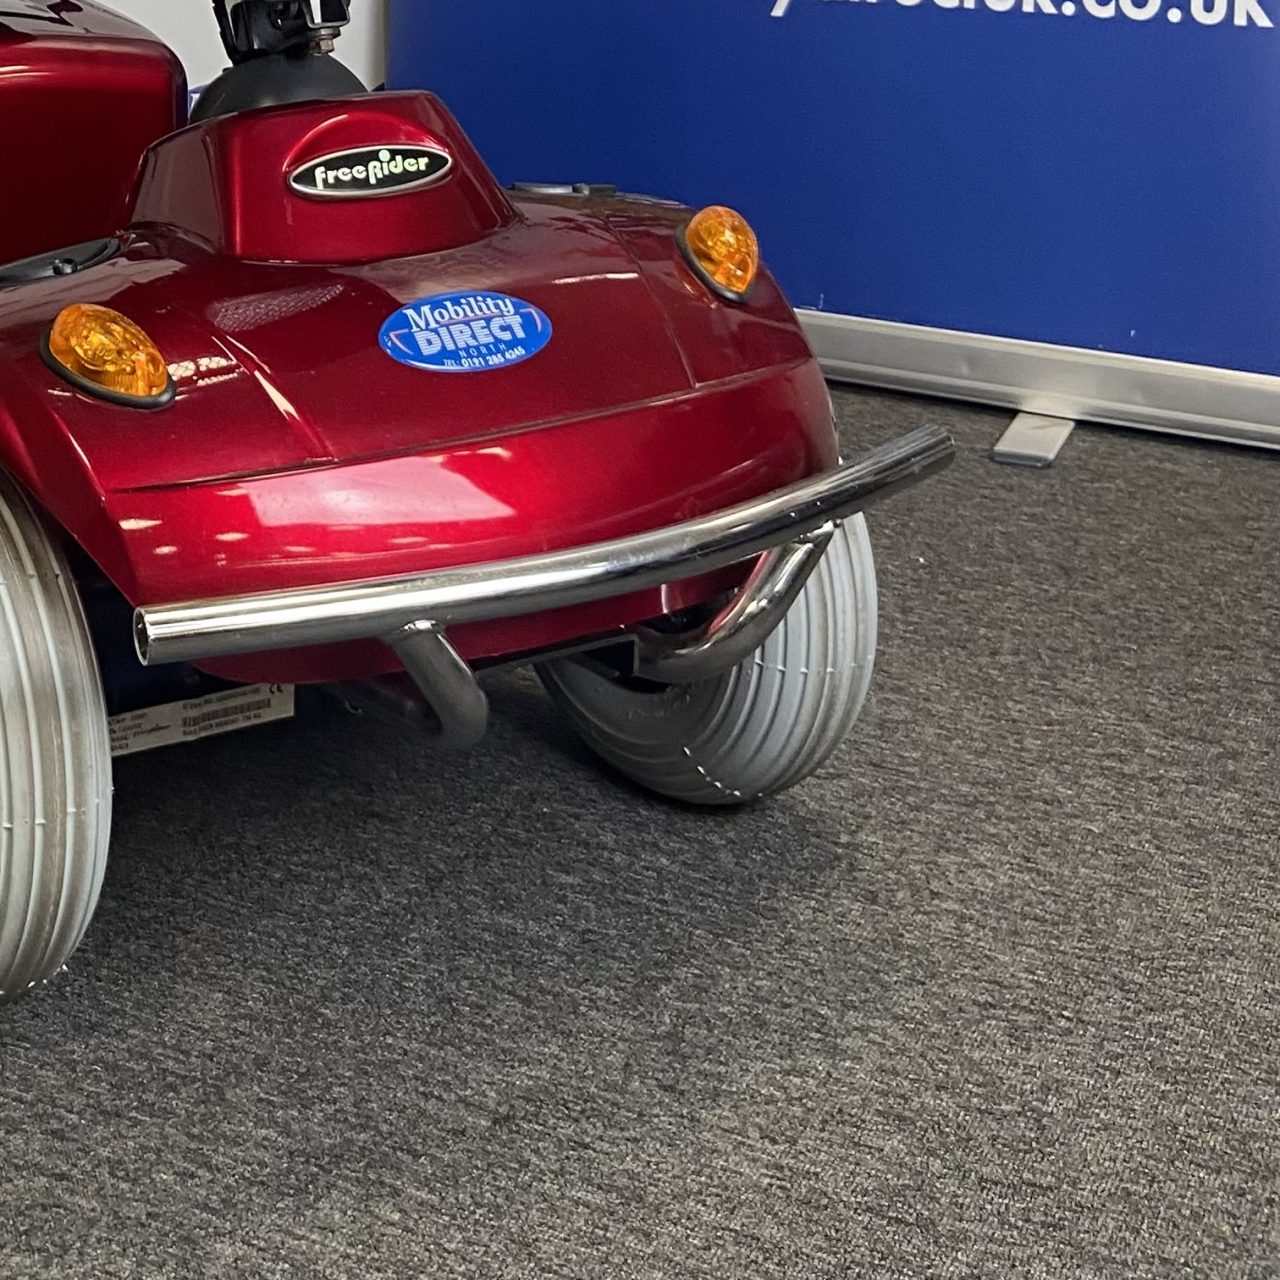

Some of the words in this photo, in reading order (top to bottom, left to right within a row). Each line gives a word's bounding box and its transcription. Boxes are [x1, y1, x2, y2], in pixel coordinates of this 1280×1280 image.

[402, 296, 515, 332] Mobility
[414, 315, 526, 356] DIRECT
[459, 343, 507, 358] NORTH
[461, 356, 485, 368] 0191
[505, 347, 526, 361] 4245
